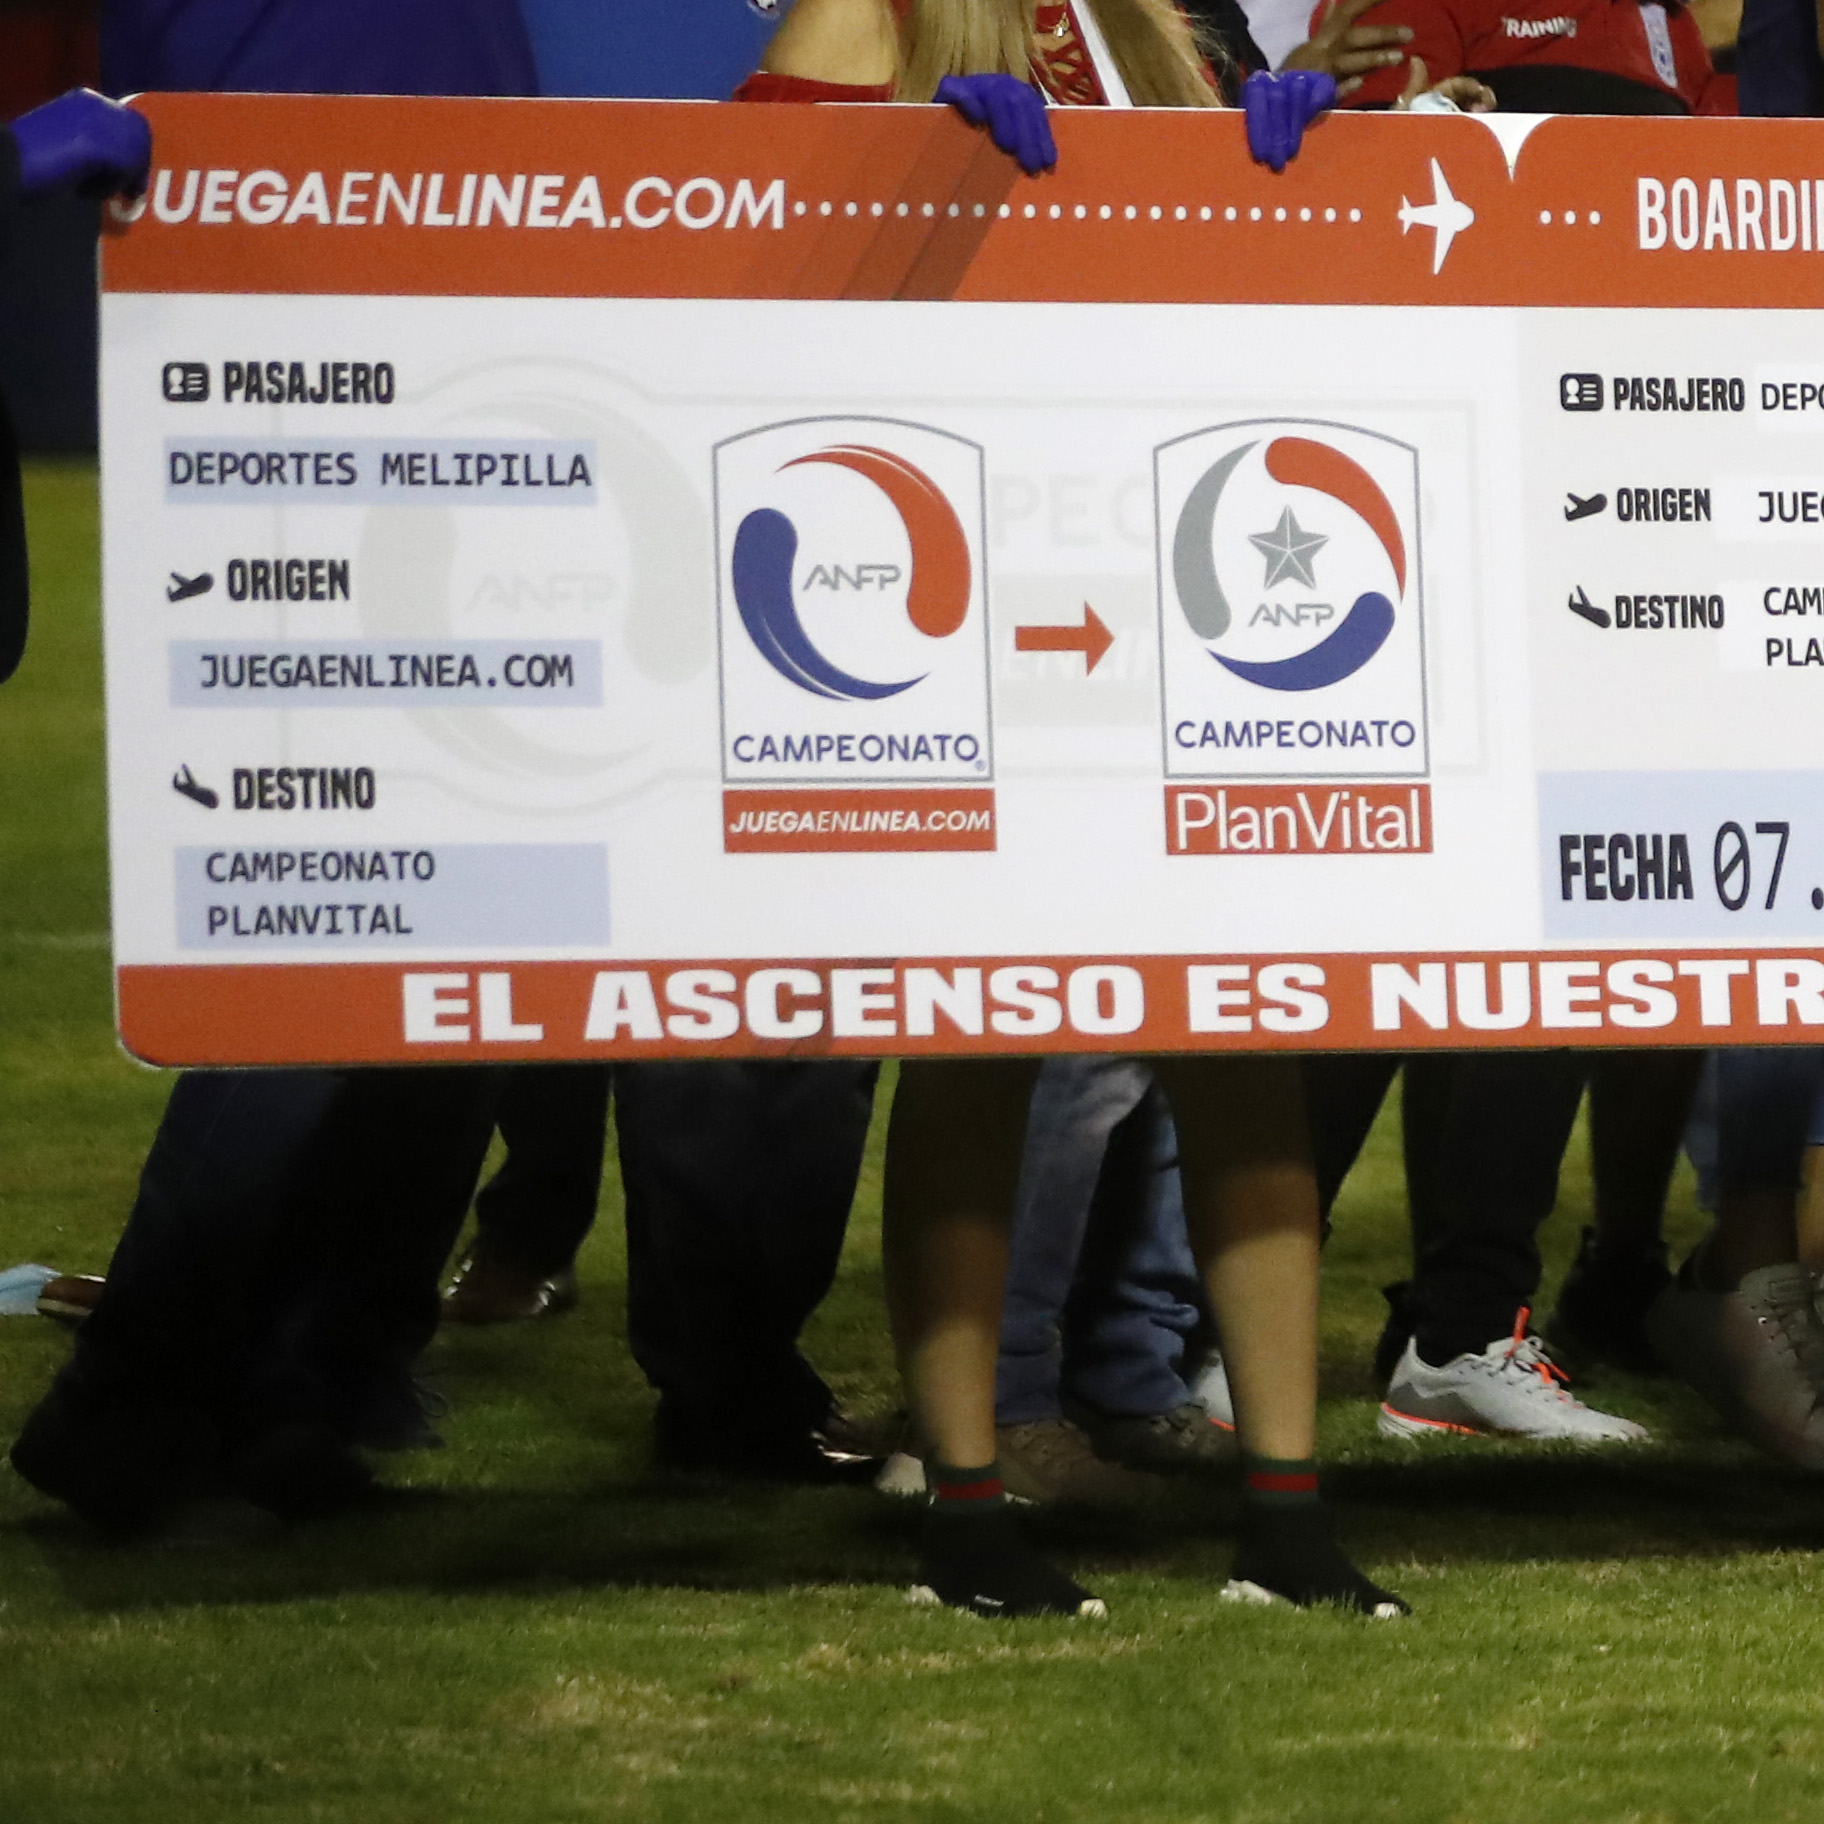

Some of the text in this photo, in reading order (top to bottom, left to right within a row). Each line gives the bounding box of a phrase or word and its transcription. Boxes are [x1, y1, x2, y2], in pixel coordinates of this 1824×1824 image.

[223, 361, 395, 405] PASAJERO
[1613, 377, 1745, 412] PASAJERO
[169, 451, 592, 487] DEPORTES MELIPILLA
[1616, 487, 1711, 522] ORIGEN
[227, 558, 350, 602] ORIGEN
[802, 564, 901, 591] ANFP
[1248, 603, 1335, 627] ANFP
[1614, 594, 1725, 630] DESTINO
[201, 654, 573, 689] JUEGAENLINEA.COM
[732, 733, 980, 764] CAMPEONATO
[1174, 720, 1416, 749] CAMPEONATO
[232, 766, 375, 811] DESTINO
[729, 809, 991, 834] JUEGAENLINEA.COM
[1177, 790, 1421, 851] PlanVital
[205, 850, 435, 883] CAMPEONATO
[1559, 833, 1694, 902] FECHA
[208, 904, 413, 936] PLANVITAL
[402, 972, 544, 1043] EL
[584, 964, 1145, 1040] ASCENSO
[1186, 962, 1330, 1033] ES
